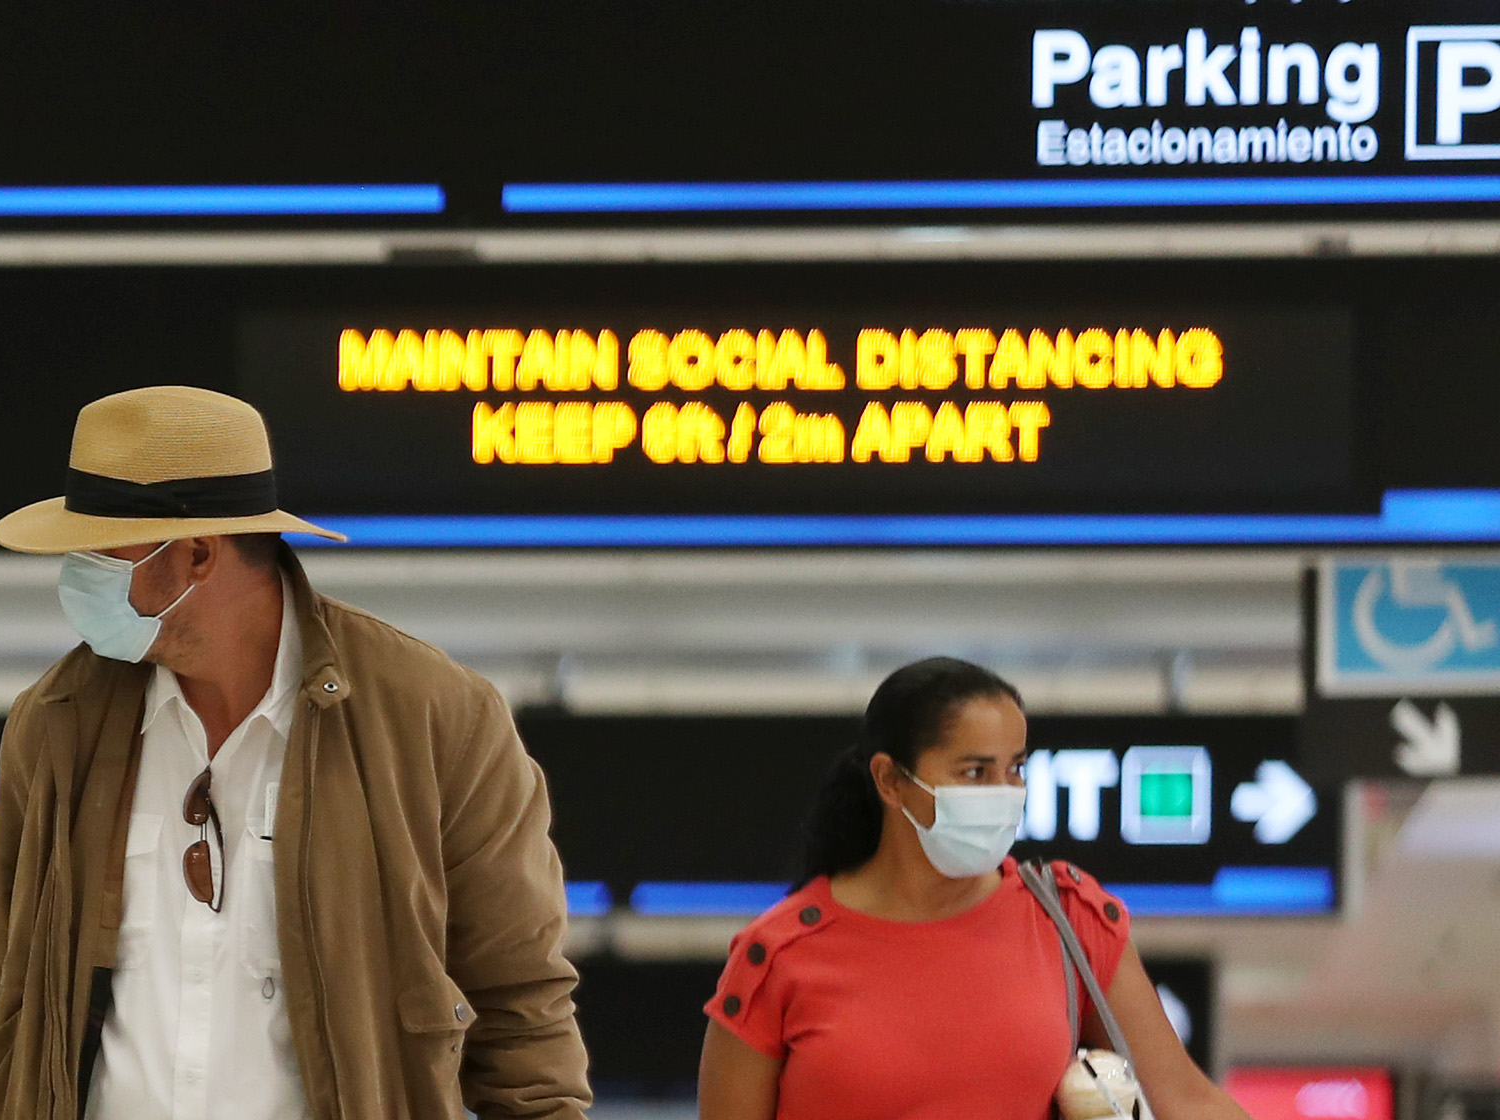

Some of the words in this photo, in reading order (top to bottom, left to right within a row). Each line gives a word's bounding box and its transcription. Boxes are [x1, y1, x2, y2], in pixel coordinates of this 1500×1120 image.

[1032, 26, 1381, 124] Parking
[1036, 117, 1379, 166] Estacionamiento
[338, 328, 619, 391] MAINTAIN
[627, 328, 846, 391] SOCIAL
[856, 327, 1224, 391] DISTANCING
[472, 401, 637, 464] KEEP
[851, 401, 1052, 464] APART
[1015, 748, 1120, 841] IT
